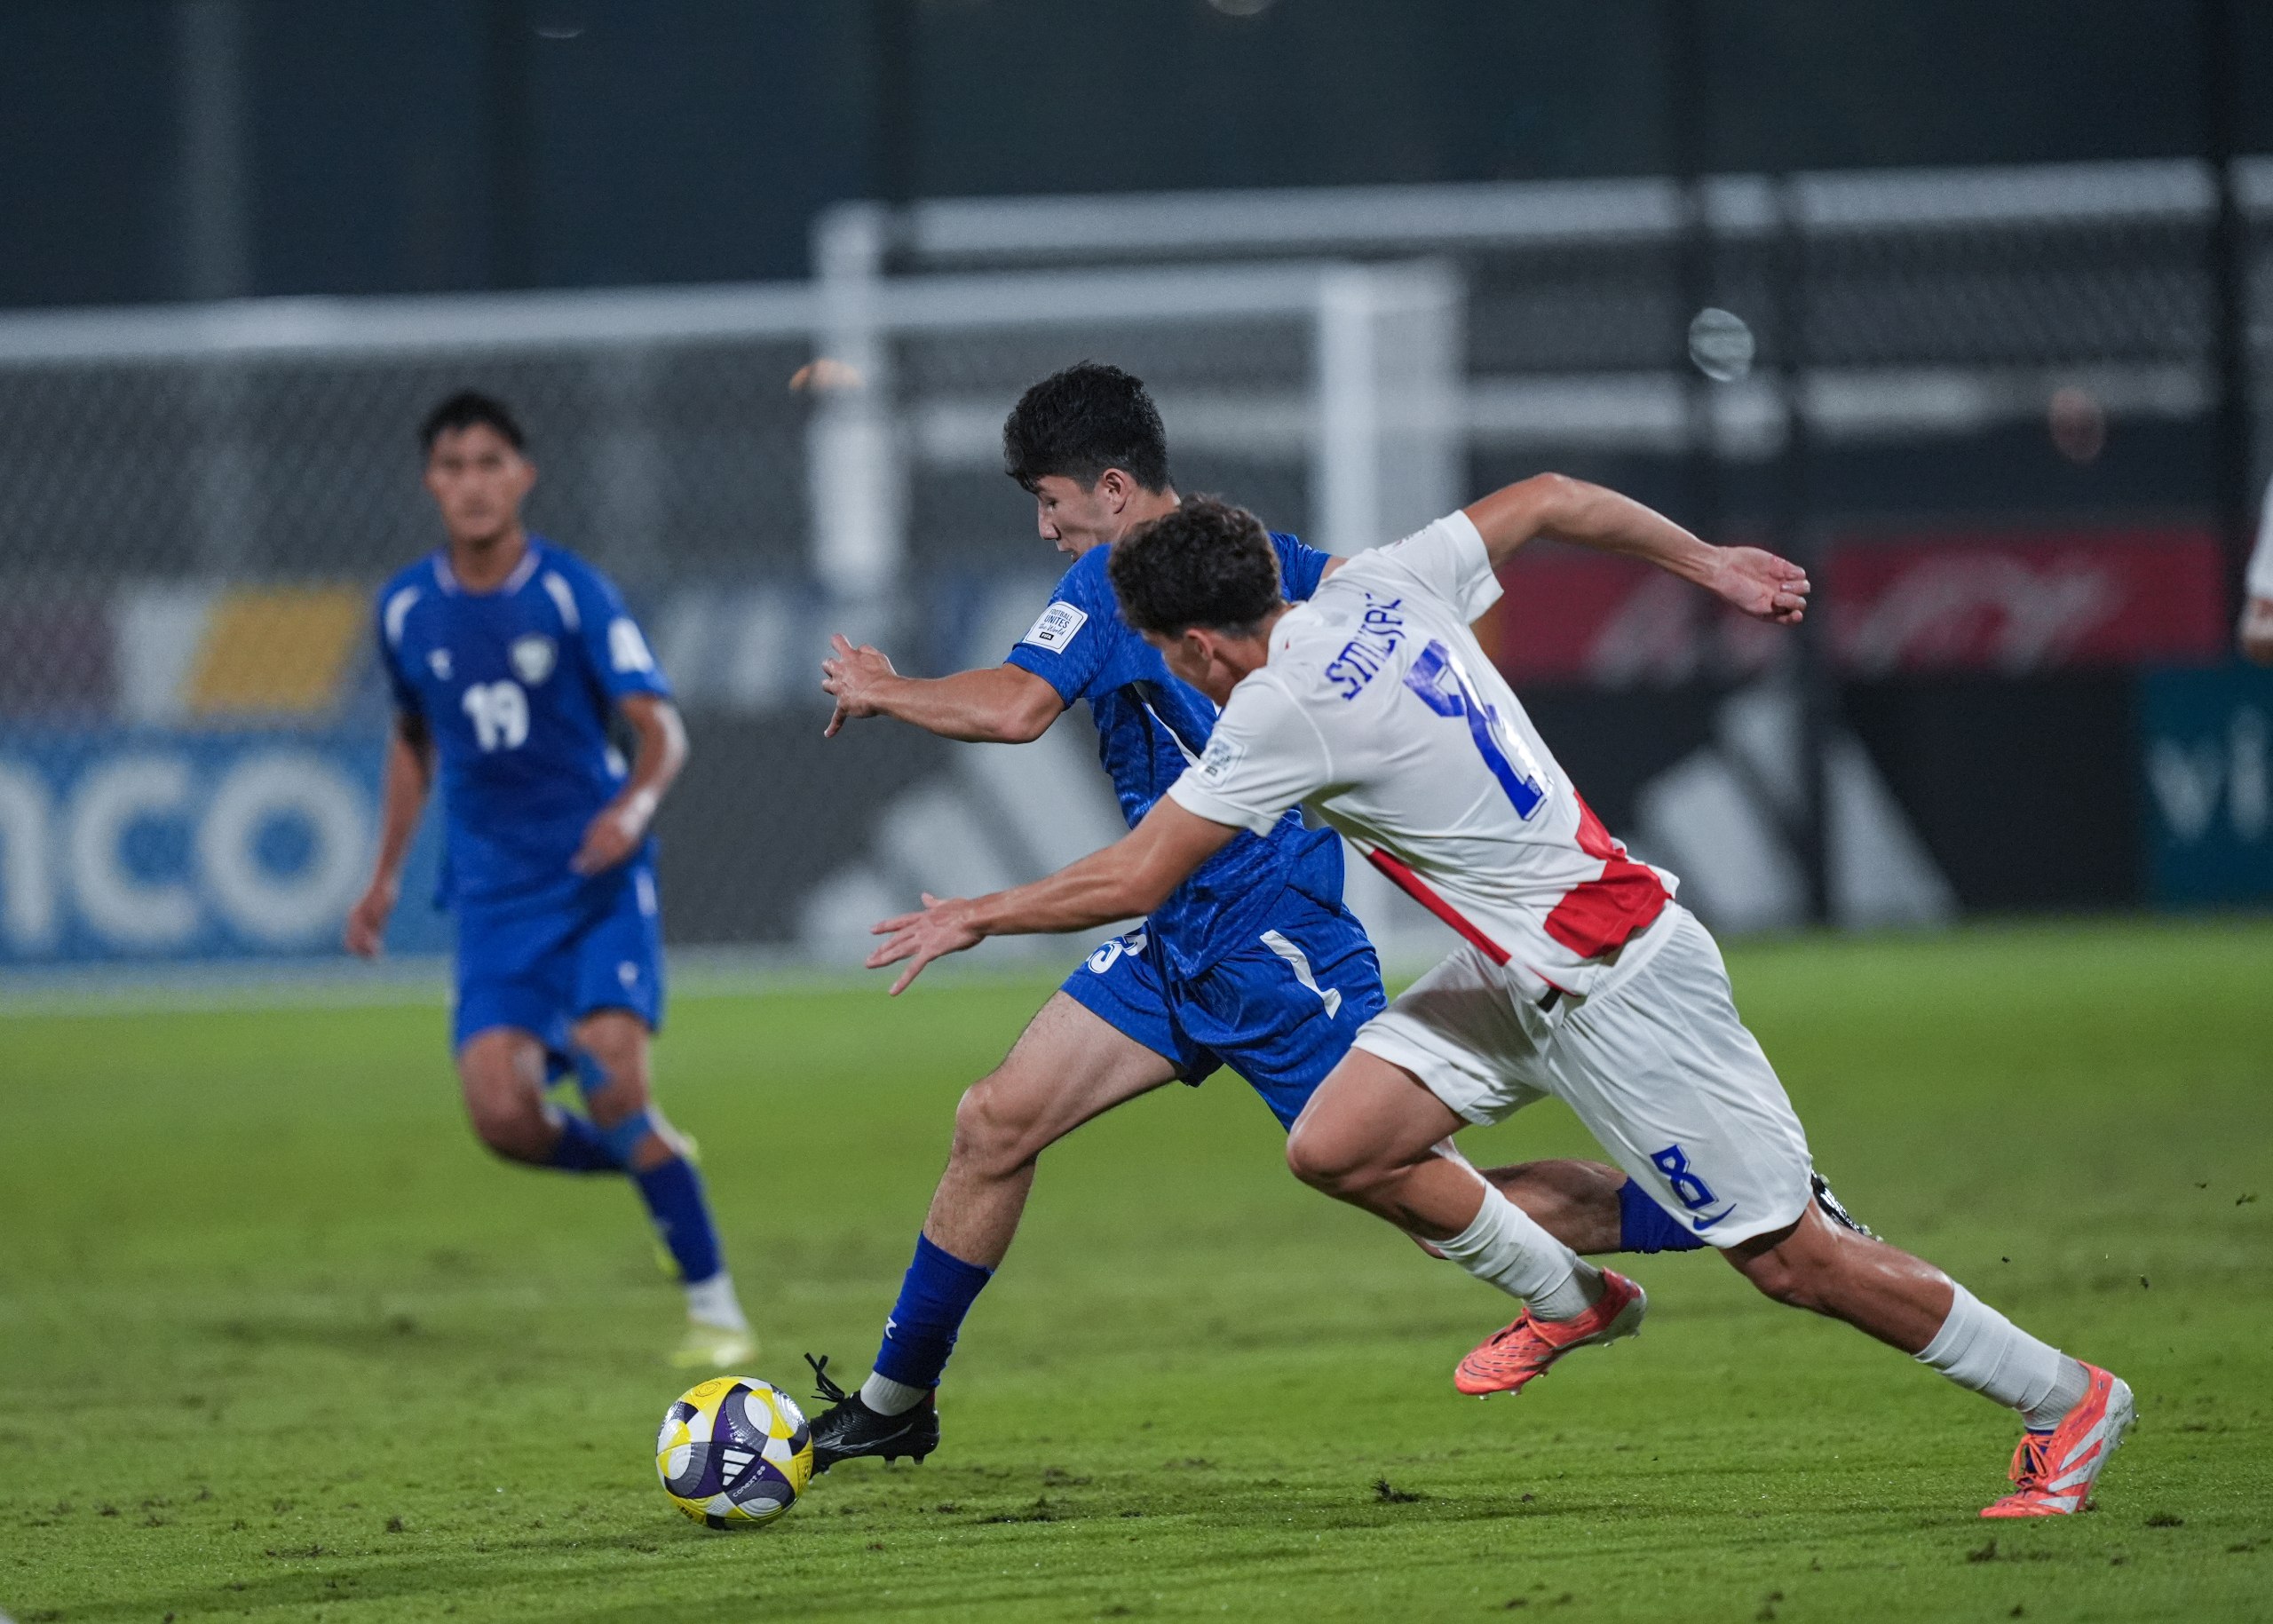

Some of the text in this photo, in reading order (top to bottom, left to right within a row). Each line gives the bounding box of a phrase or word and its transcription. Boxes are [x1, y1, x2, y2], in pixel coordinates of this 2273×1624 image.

[1044, 614, 1070, 629] UNITES
[1049, 609, 1073, 622] FOOTBALL
[1048, 625, 1066, 636] World
[462, 680, 531, 752] 19
[1650, 1144, 1719, 1211] 8
